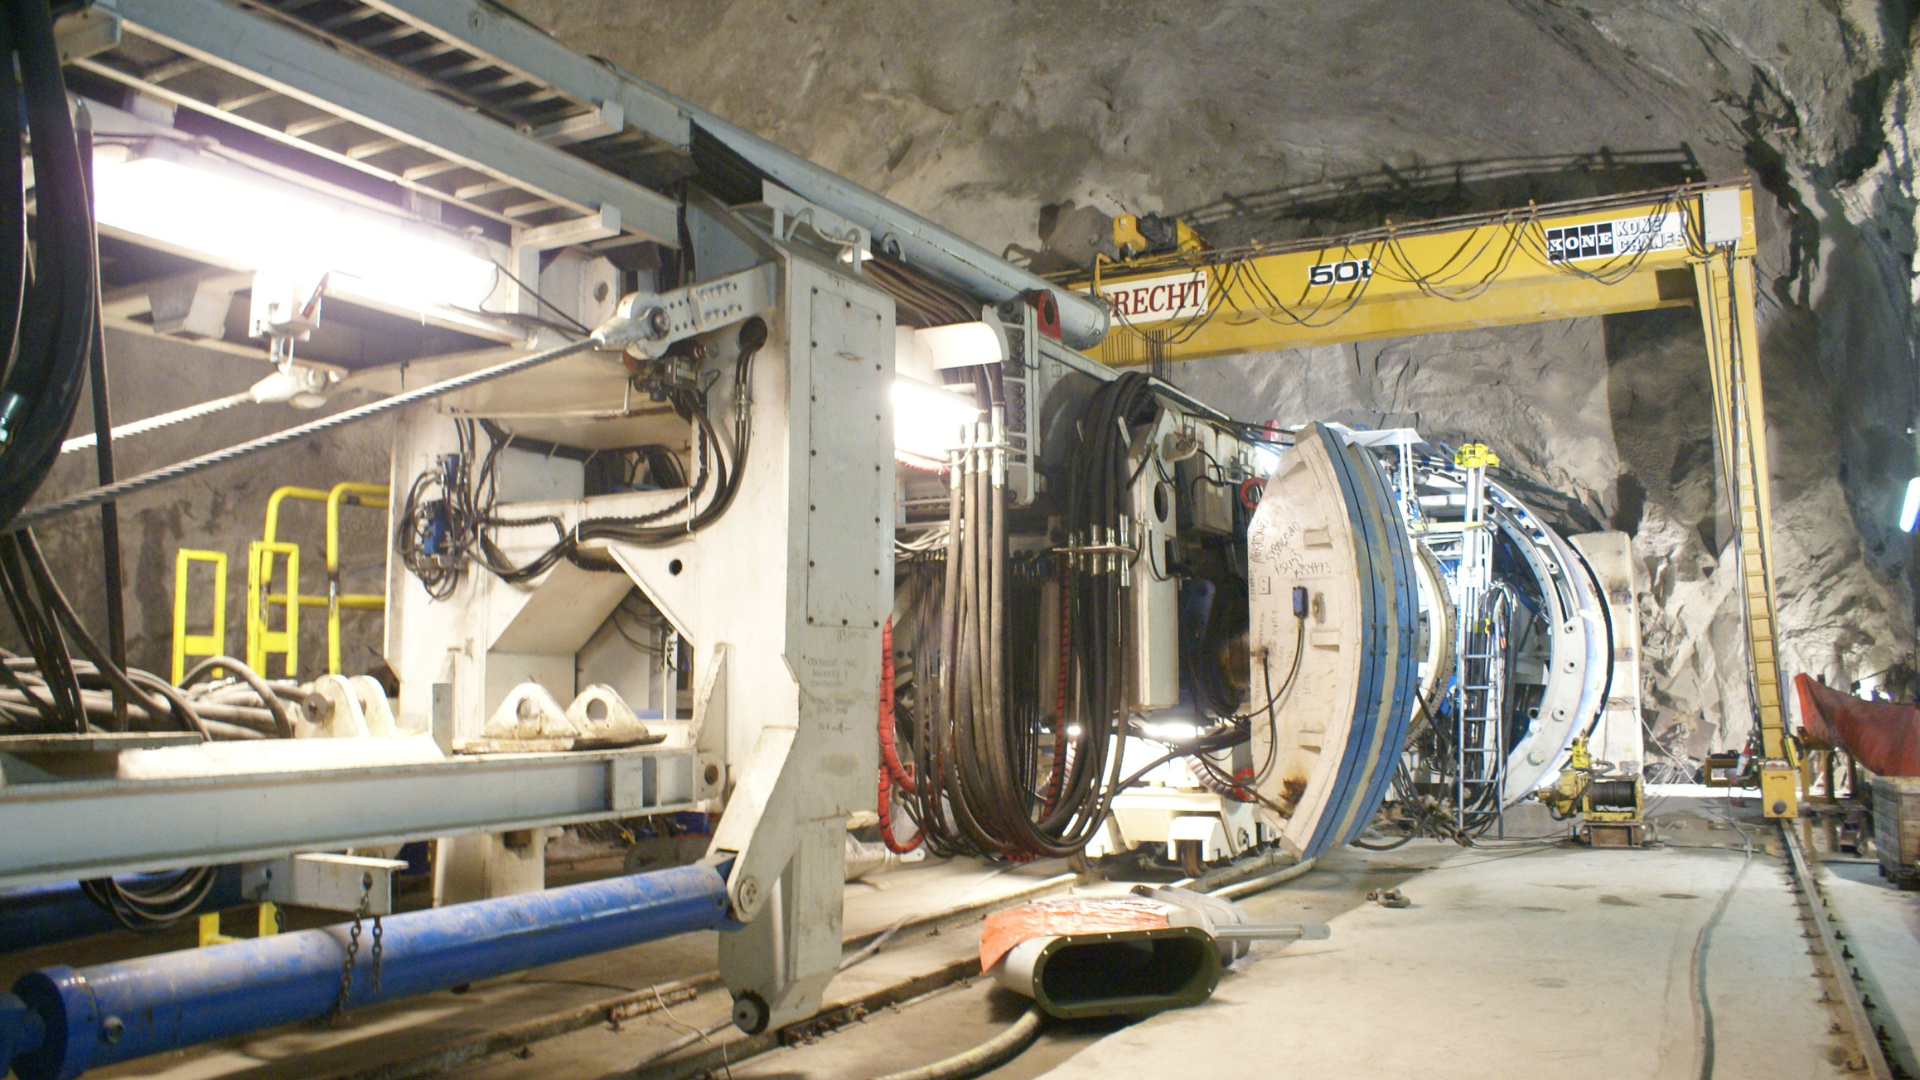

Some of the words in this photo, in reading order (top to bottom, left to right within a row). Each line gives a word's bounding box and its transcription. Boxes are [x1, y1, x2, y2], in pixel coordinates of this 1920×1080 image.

[1549, 232, 1613, 252] KONE
[1310, 260, 1371, 285] 50t
[1108, 280, 1205, 317] RECHT
